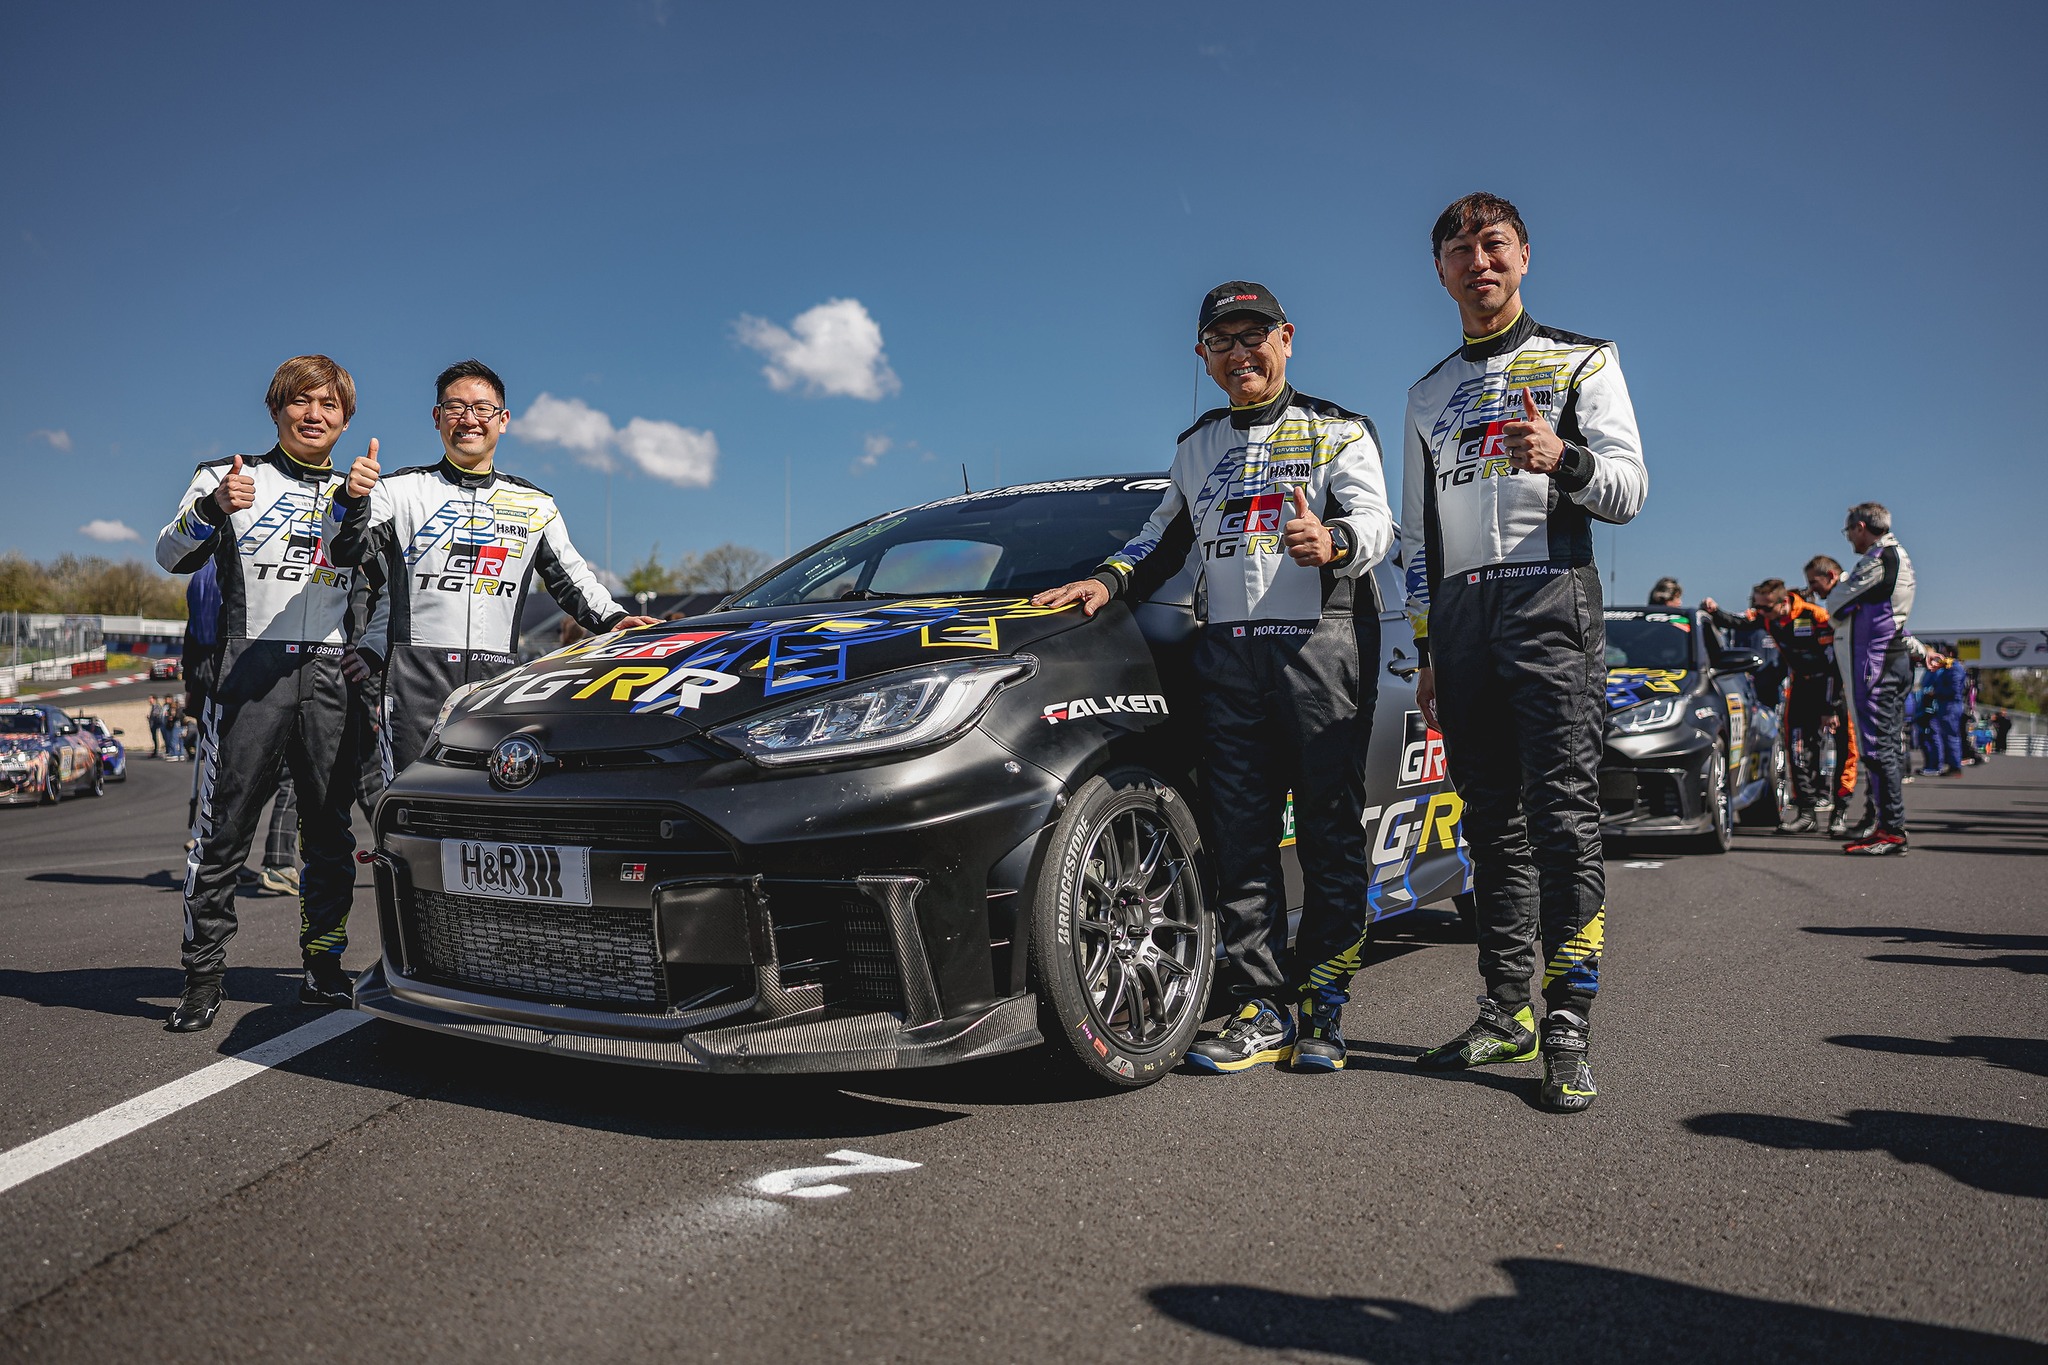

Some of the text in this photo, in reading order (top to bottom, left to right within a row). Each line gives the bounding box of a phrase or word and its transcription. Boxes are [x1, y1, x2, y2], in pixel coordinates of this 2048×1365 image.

[1220, 509, 1279, 533] GR
[253, 563, 348, 590] TG-RR
[446, 554, 503, 576] GR
[1486, 565, 1548, 580] H.ISHIURA
[415, 574, 517, 598] TG-RR
[1253, 625, 1298, 637] MORIZO
[471, 653, 507, 663] D.TOYODA
[581, 639, 696, 660] GR
[468, 666, 741, 712] TG-RR
[1042, 694, 1169, 725] FALKEN
[1402, 739, 1447, 782] GR
[461, 842, 525, 894] H&R
[622, 867, 644, 880] GR
[1056, 815, 1090, 945] BRIDGESTONE
